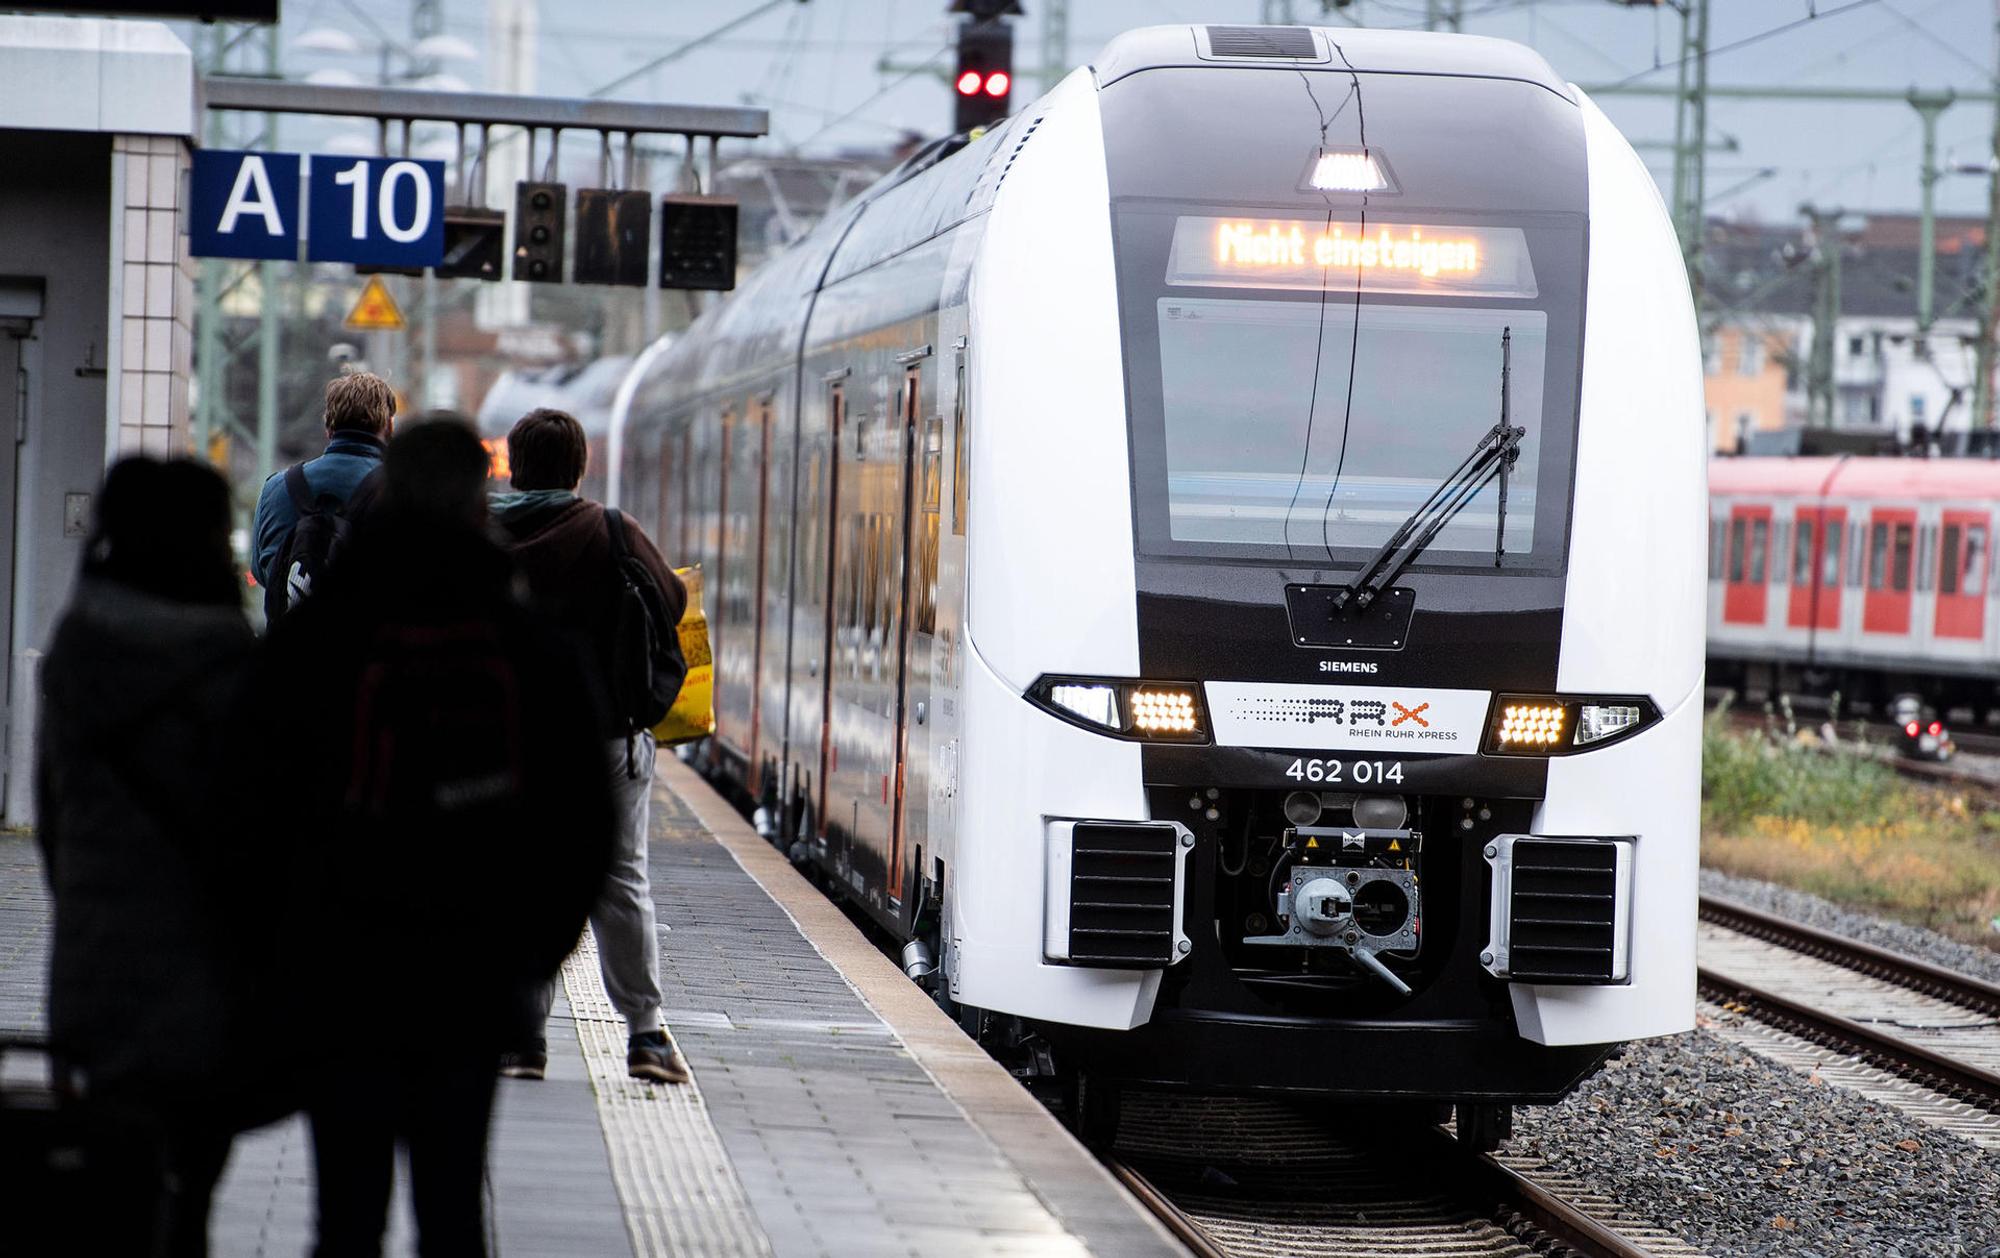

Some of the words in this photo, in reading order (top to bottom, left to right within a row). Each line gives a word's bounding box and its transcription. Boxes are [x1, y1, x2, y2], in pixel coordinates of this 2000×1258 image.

[217, 156, 285, 236] A
[335, 160, 432, 243] 10
[1218, 222, 1304, 265] Nicht
[1313, 227, 1477, 277] einsteigen
[1319, 660, 1378, 673] SIEMENS
[1307, 698, 1429, 727] RRX
[1349, 728, 1381, 738] RHEIN
[1385, 729, 1415, 739] RUHR
[1417, 730, 1458, 741] XPRESS
[1285, 758, 1342, 782] 462
[1352, 760, 1404, 784] 014
